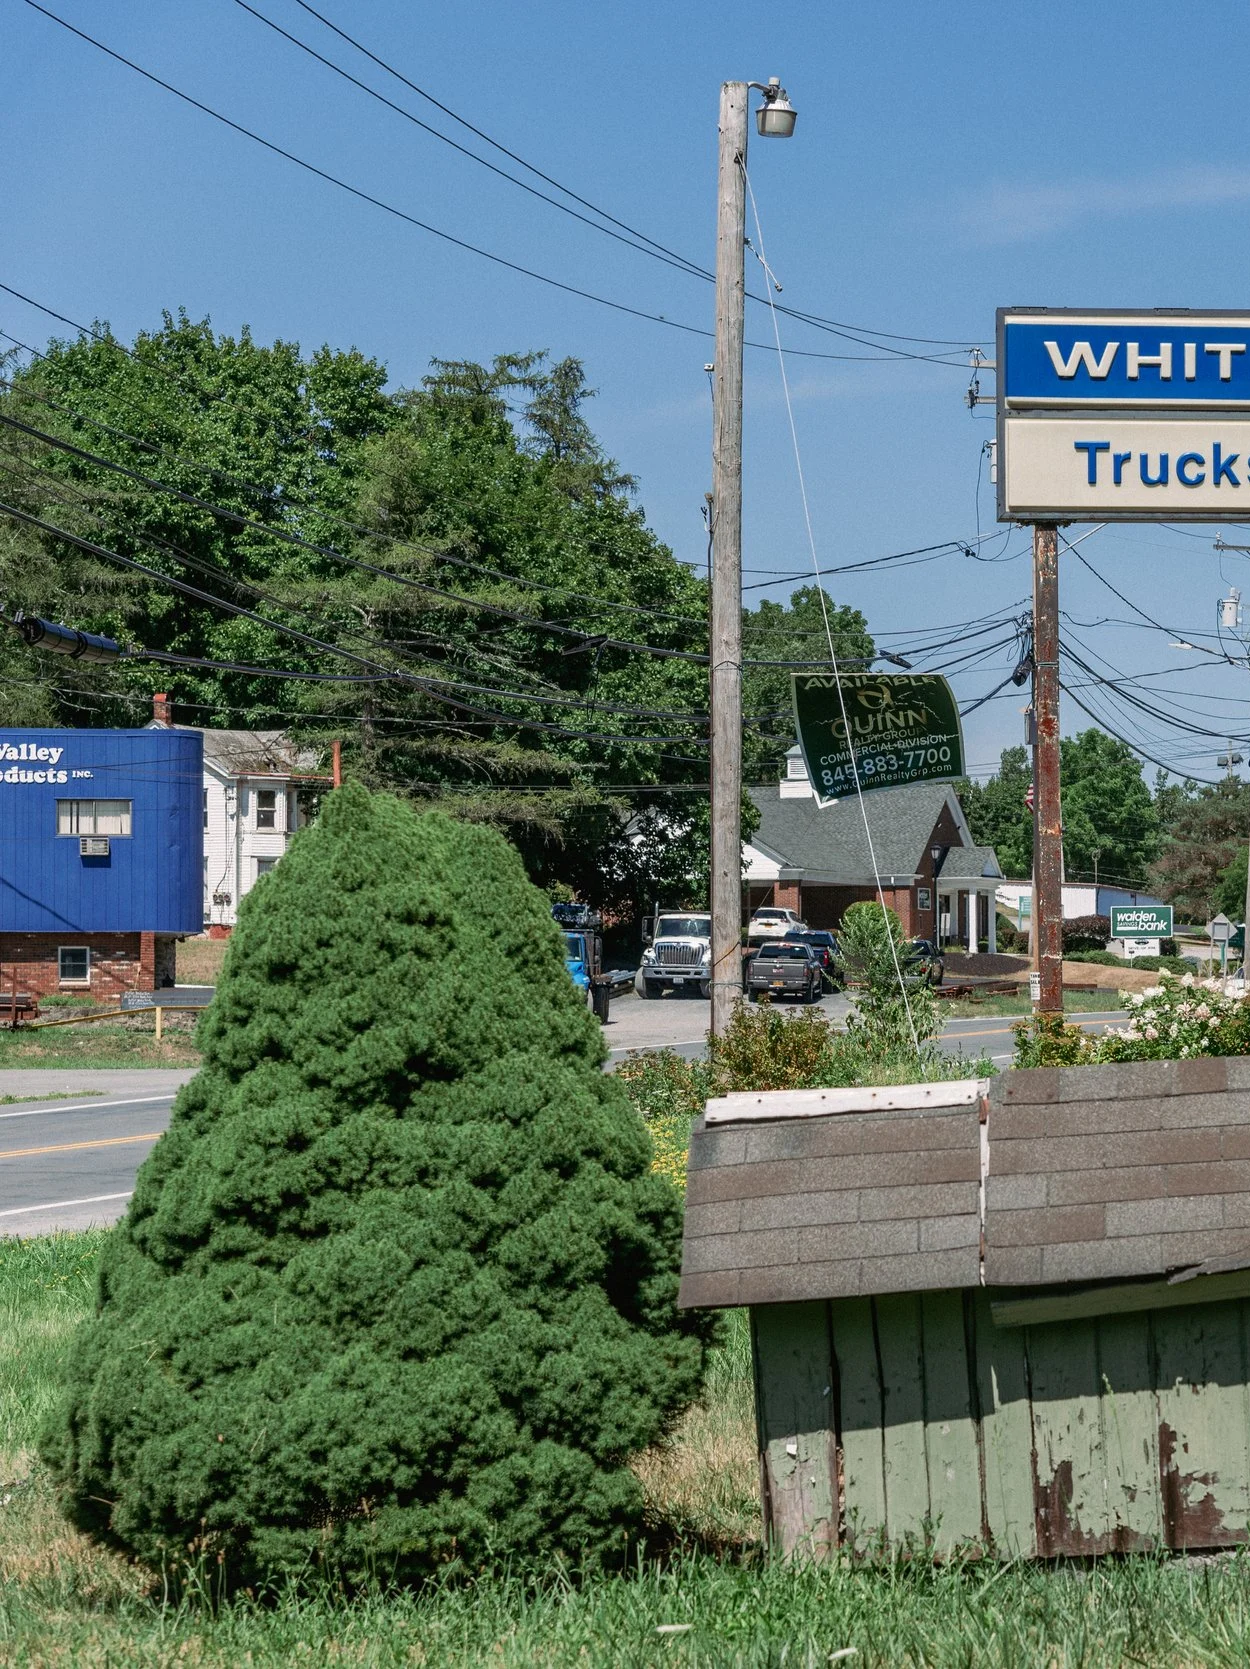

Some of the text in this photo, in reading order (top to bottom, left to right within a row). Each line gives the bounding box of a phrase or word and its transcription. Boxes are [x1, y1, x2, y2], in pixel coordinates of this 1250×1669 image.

[830, 709, 928, 739] QUINN
[820, 734, 947, 766] COMMERCIAL DIVISION
[839, 727, 924, 750] REALTY GROUP
[0, 766, 94, 784] ducts INC.
[821, 746, 951, 786] 845-883-7700
[826, 764, 952, 795] www.QuinnRealtyGrp.com
[1117, 910, 1157, 922] walden
[1138, 920, 1168, 931] bank
